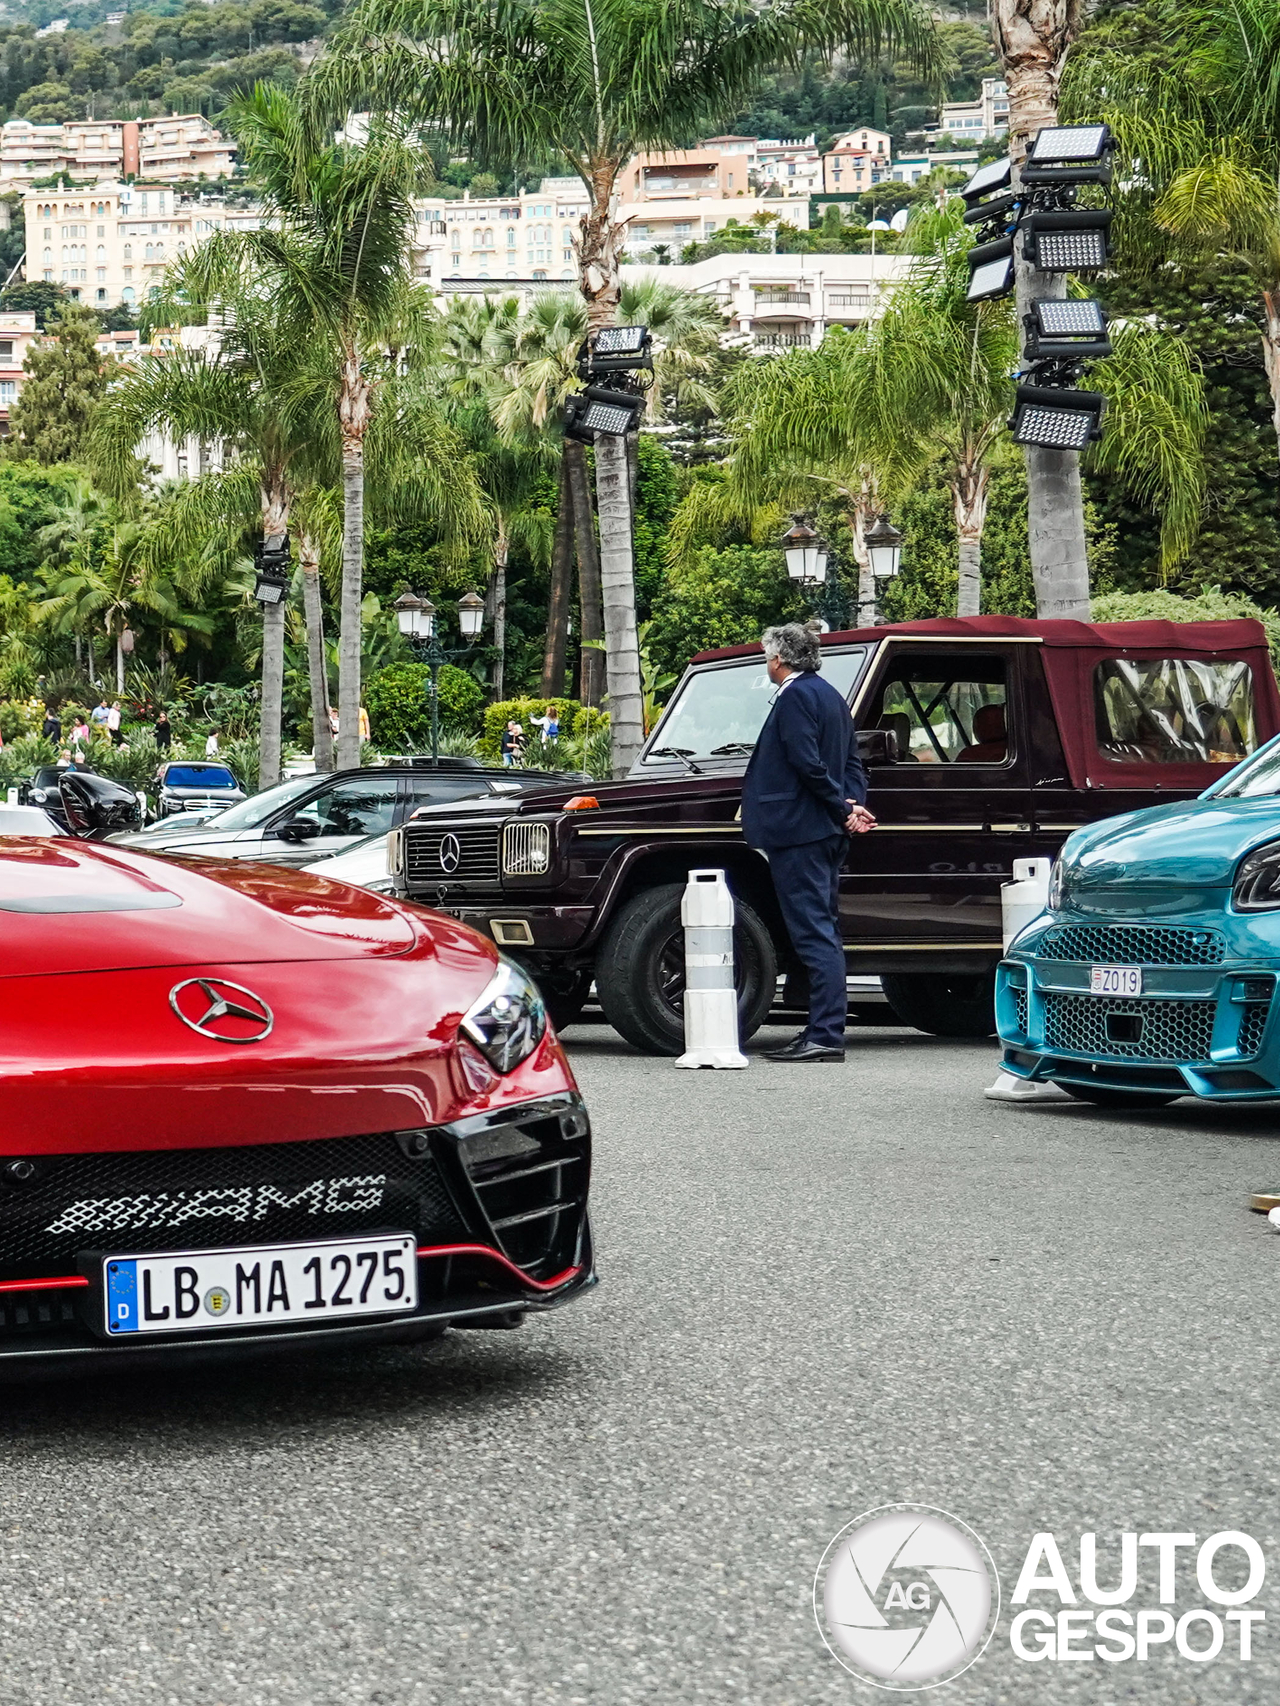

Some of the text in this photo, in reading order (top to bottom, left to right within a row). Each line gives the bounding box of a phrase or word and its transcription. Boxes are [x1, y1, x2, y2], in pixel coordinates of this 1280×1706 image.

[1103, 971, 1137, 992] Z019
[166, 1175, 386, 1228] AMG
[143, 1249, 405, 1321] LB MA 1275
[117, 1303, 130, 1320] D
